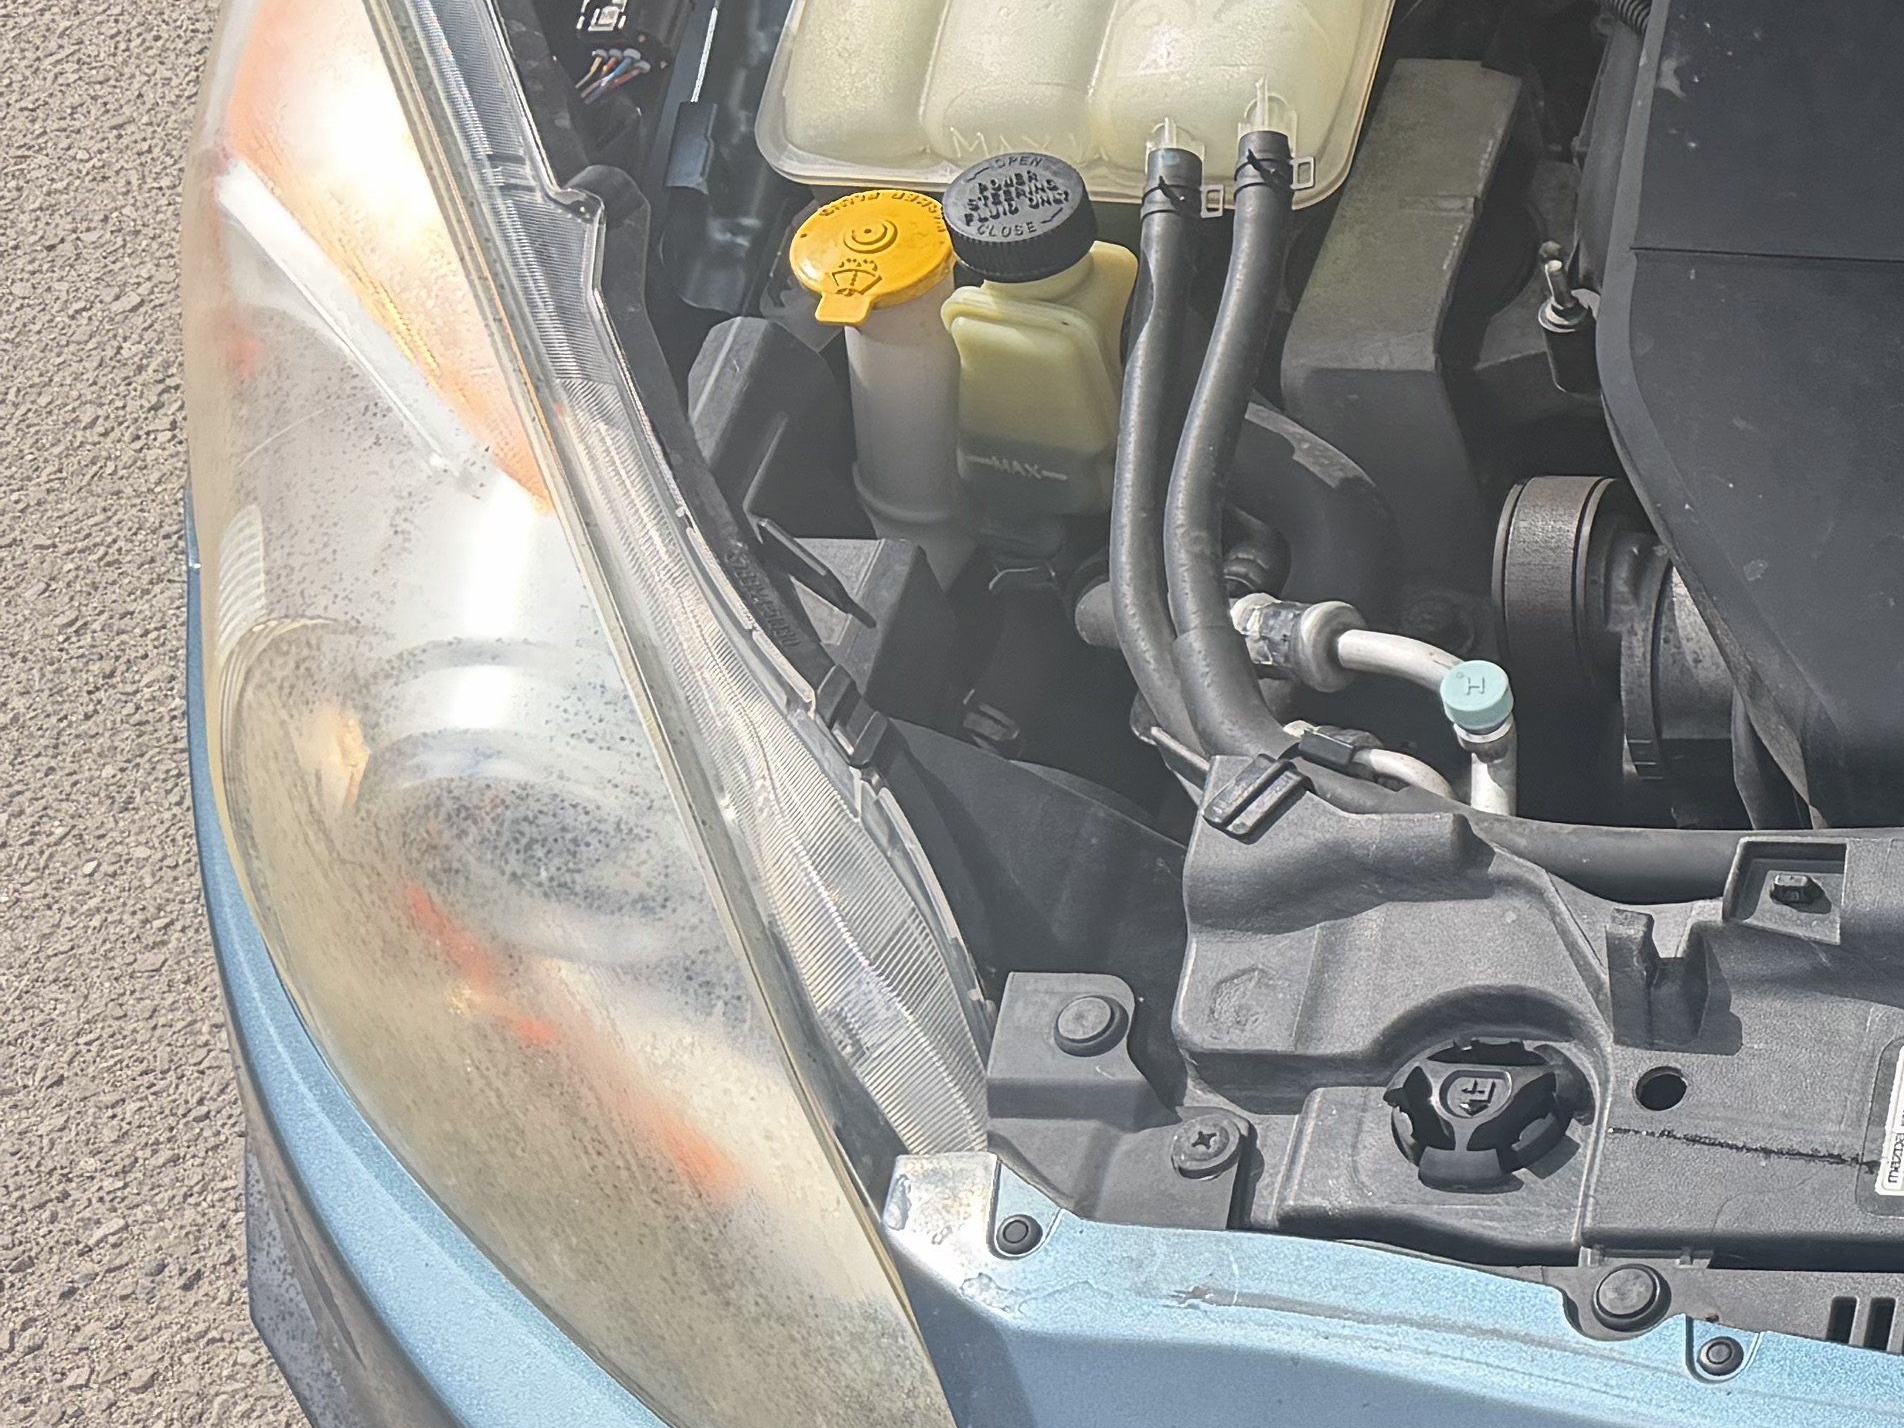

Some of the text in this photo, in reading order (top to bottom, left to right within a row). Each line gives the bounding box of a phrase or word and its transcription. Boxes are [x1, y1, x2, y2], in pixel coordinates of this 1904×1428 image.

[995, 155, 1043, 169] OPEN
[978, 170, 1038, 194] POWER
[967, 179, 1060, 212] STEERING
[964, 190, 1070, 227] FLUID ONLY
[977, 221, 1037, 238] CLOSE
